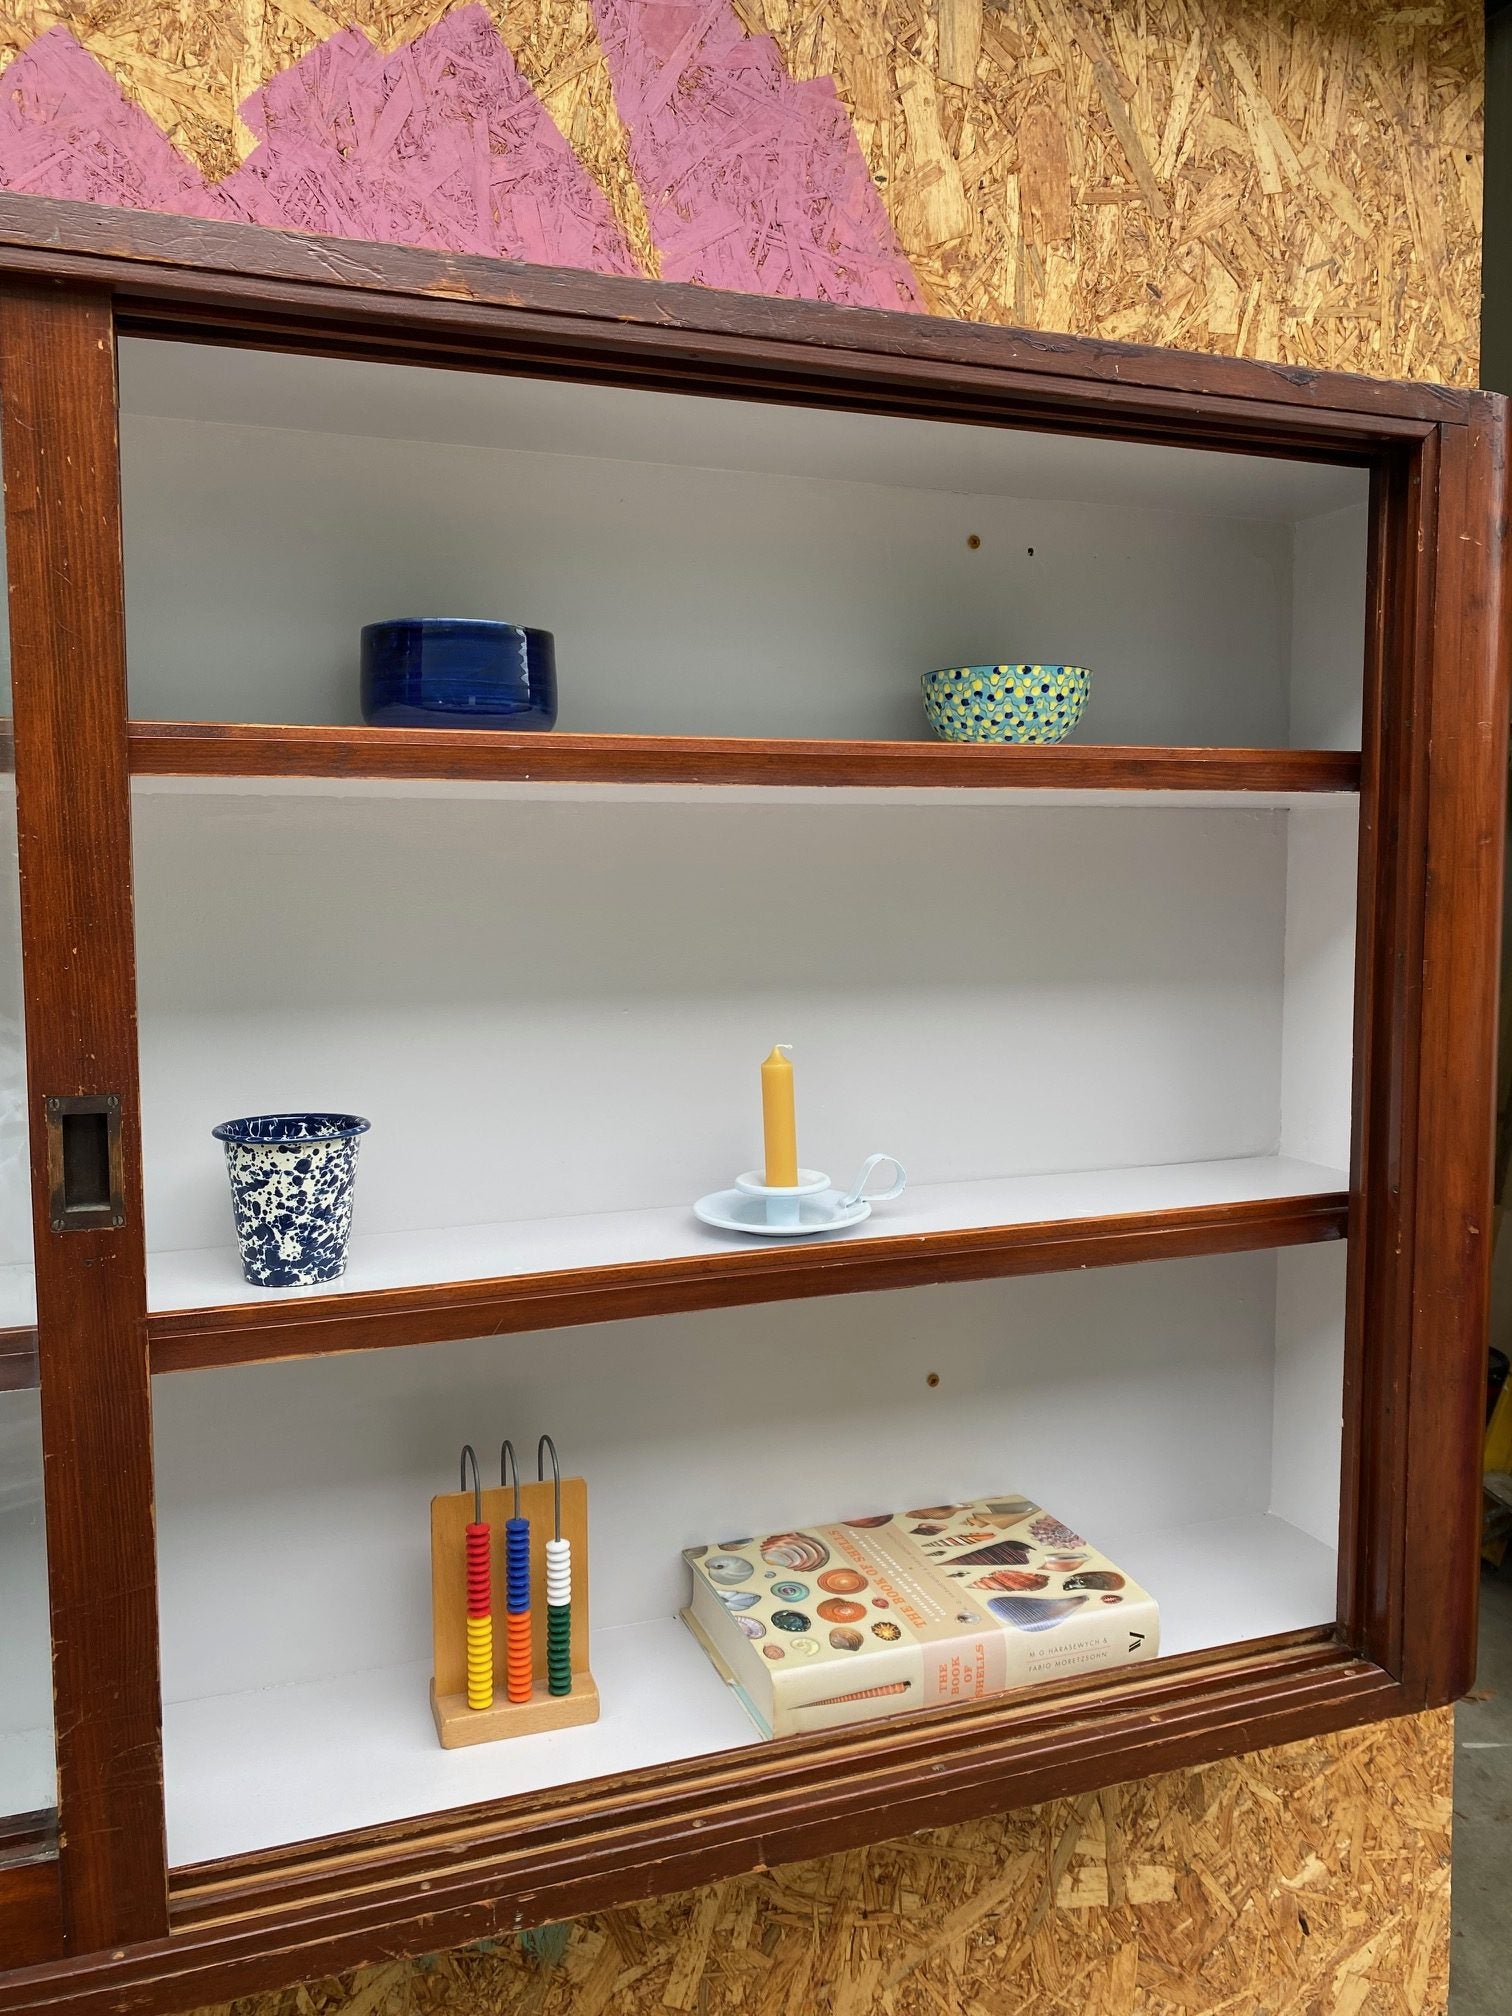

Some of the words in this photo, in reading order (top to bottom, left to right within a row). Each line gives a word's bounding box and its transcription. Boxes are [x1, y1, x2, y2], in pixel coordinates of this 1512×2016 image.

[828, 1530, 867, 1562] SHELLS
[860, 1563, 880, 1576] OF
[872, 1577, 906, 1604] BOOK
[898, 1605, 928, 1628] THE
[938, 1664, 947, 1693] THE
[951, 1656, 960, 1696] BOOK
[964, 1665, 972, 1683] OF
[975, 1643, 984, 1698] SHELLS
[1027, 1662, 1052, 1673] FABIO
